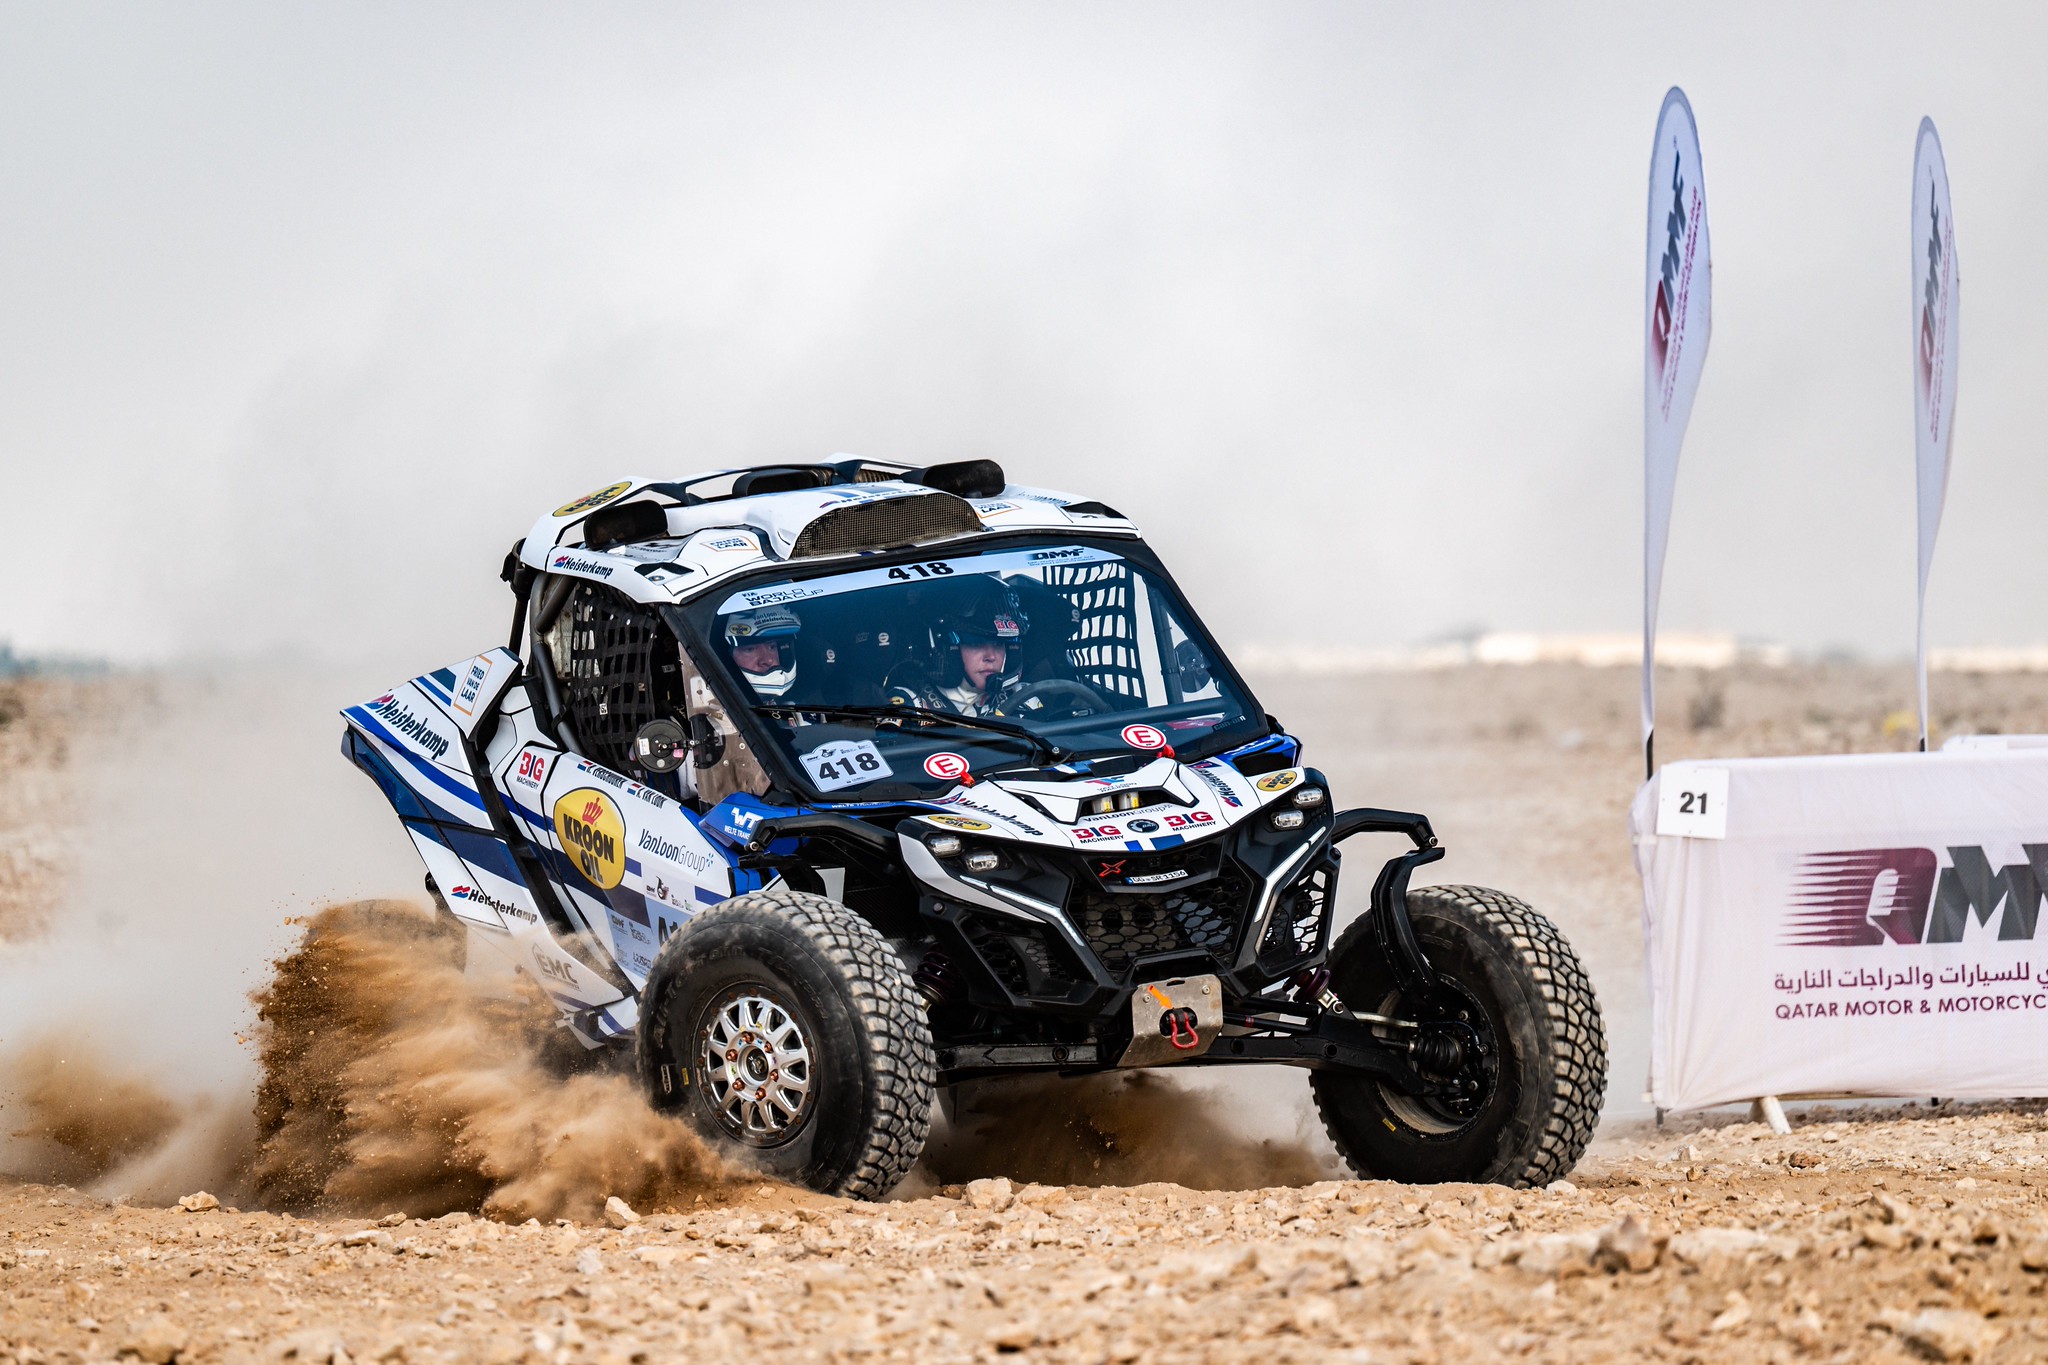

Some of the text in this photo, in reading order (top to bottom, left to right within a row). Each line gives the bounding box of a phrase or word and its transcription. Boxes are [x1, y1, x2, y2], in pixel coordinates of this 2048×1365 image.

[564, 558, 614, 580] Heisterkamp
[887, 561, 955, 581] 418
[745, 588, 805, 602] WORLD
[470, 664, 485, 680] FRIED
[460, 687, 477, 704] LAAR
[376, 698, 450, 760] Heisterkamp
[1133, 730, 1155, 744] E
[519, 752, 546, 782] BIG
[818, 752, 880, 780] 418
[934, 757, 959, 774] E
[516, 775, 540, 790] MACHINERY
[1679, 791, 1708, 815] 21
[1071, 811, 1214, 840] BIG BIG
[1080, 821, 1216, 844] MACHINERY MACHINERY
[563, 813, 614, 865] KROON
[638, 828, 706, 877] VanLoonGroup
[580, 849, 604, 884] OIL
[468, 889, 538, 924] Heisterkamp
[1775, 843, 2048, 947] QM
[535, 952, 578, 985] EMC
[1838, 966, 1934, 991] والدراجات
[1939, 962, 2030, 987] للسيارات
[1774, 969, 1832, 994] النارية
[1775, 1001, 1839, 1020] QATAR
[1845, 999, 1913, 1017] MOTOR
[1920, 999, 1931, 1014] &
